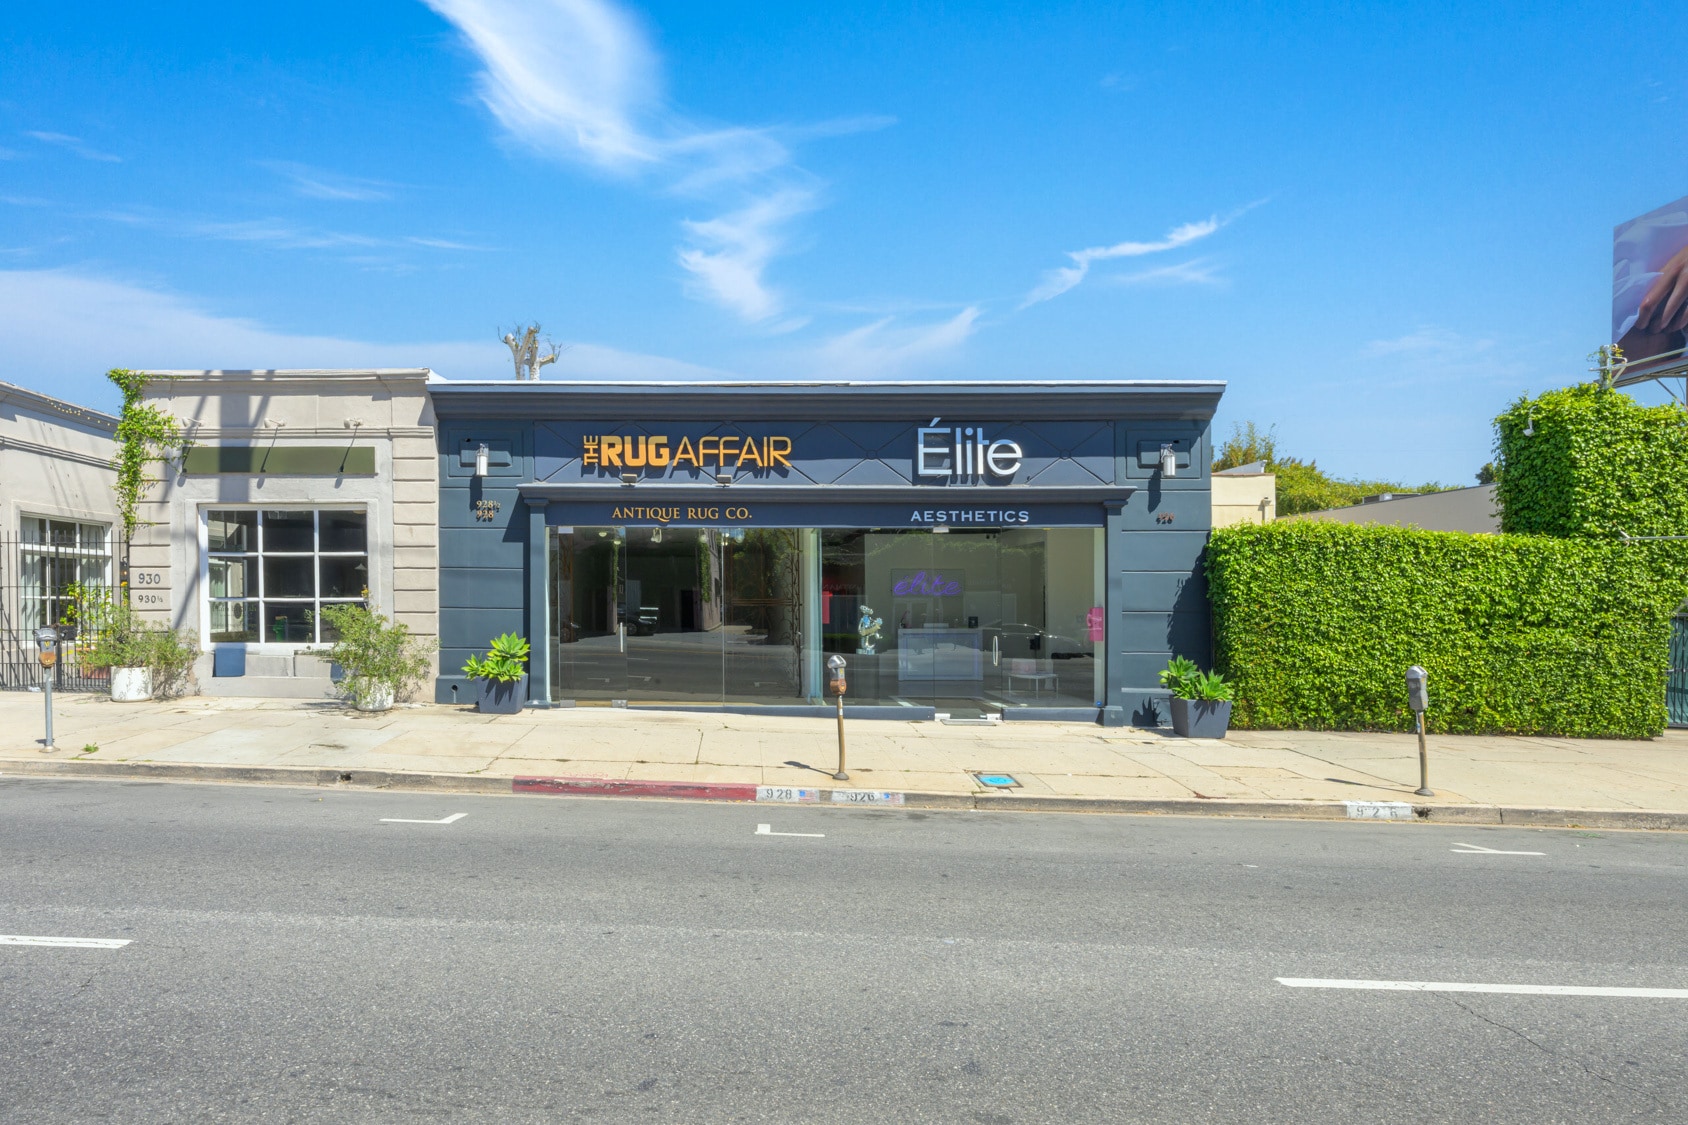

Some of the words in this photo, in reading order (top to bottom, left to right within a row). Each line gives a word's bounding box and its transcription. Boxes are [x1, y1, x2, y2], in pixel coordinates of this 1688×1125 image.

[583, 435, 598, 465] THE
[601, 435, 670, 467] RUG
[672, 435, 793, 467] AFFAIR
[918, 417, 1023, 475] Élite
[612, 507, 680, 522] ANTIQUE
[687, 507, 719, 519] RUG
[725, 507, 753, 519] CO.
[910, 510, 1030, 522] AESTHETICS
[138, 573, 161, 584] 930
[766, 788, 793, 800] 928
